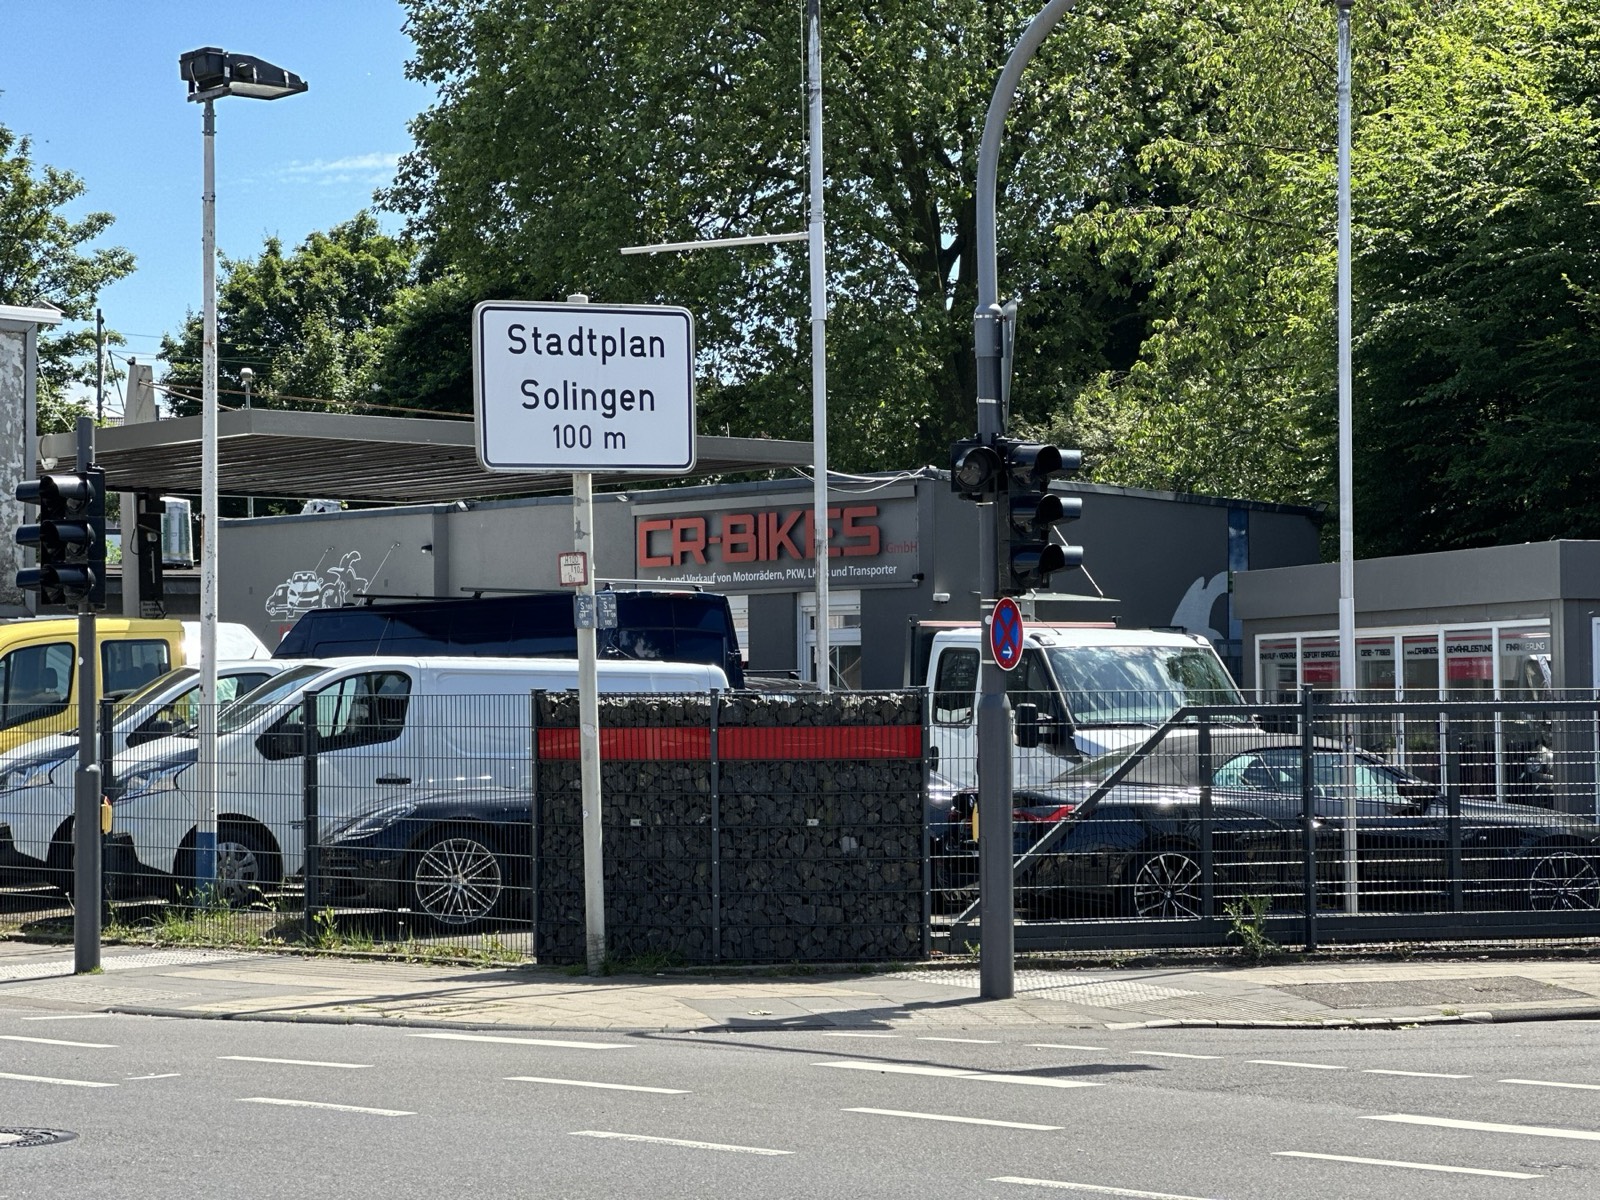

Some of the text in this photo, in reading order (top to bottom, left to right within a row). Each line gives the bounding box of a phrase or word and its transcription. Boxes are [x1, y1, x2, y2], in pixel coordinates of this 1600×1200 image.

[507, 323, 665, 365] Stadtplan
[520, 379, 655, 419] Solingen
[553, 424, 626, 450] 100 m
[638, 505, 917, 568] CR-BIKES GmbH
[670, 573, 685, 582] und
[686, 572, 716, 583] Verkauf
[717, 574, 732, 583] von
[736, 569, 785, 582] Motorrädern,
[786, 569, 806, 580] PKW,
[831, 565, 848, 577] und
[848, 565, 897, 577] Transporter
[1447, 643, 1492, 654] GEWÄHRLEISTUNG
[1506, 642, 1545, 652] FINANERUNG
